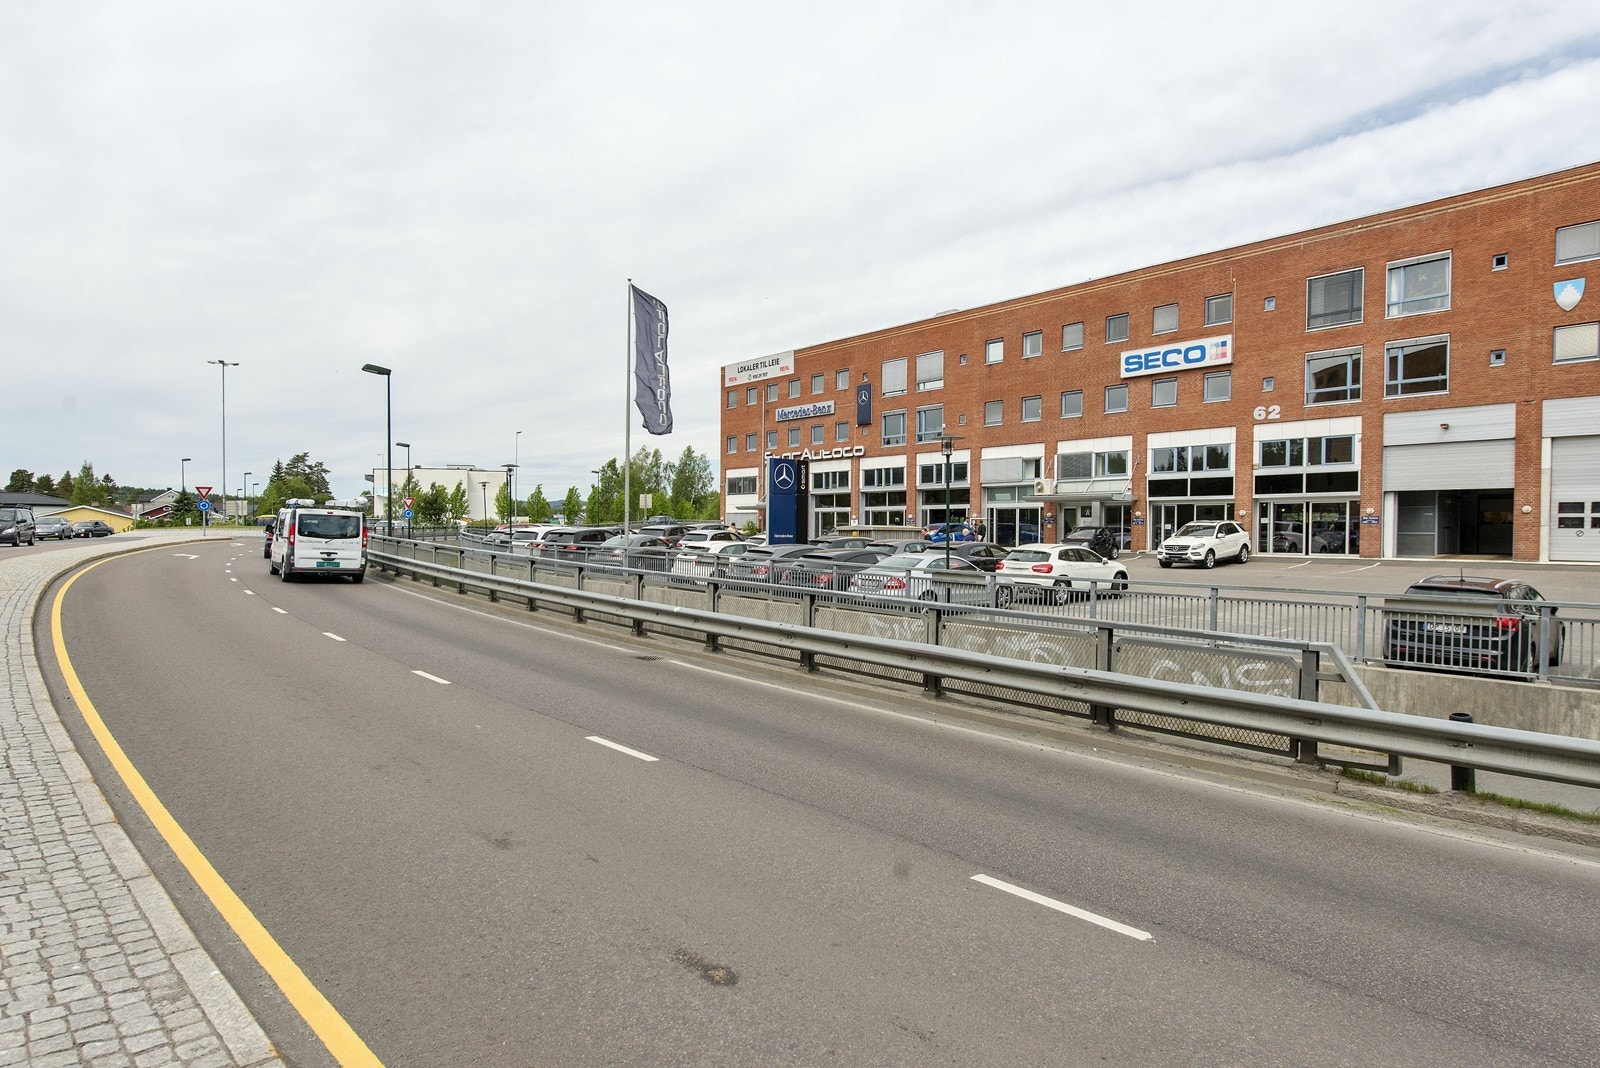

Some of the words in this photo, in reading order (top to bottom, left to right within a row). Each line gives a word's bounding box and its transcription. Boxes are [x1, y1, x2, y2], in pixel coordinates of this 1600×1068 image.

[737, 362, 759, 374] LOKALER
[760, 360, 768, 369] TIL
[768, 358, 780, 367] LEIE
[1124, 344, 1207, 373] SECO
[777, 404, 832, 420] Mercedes-Benz
[1253, 404, 1281, 421] 62
